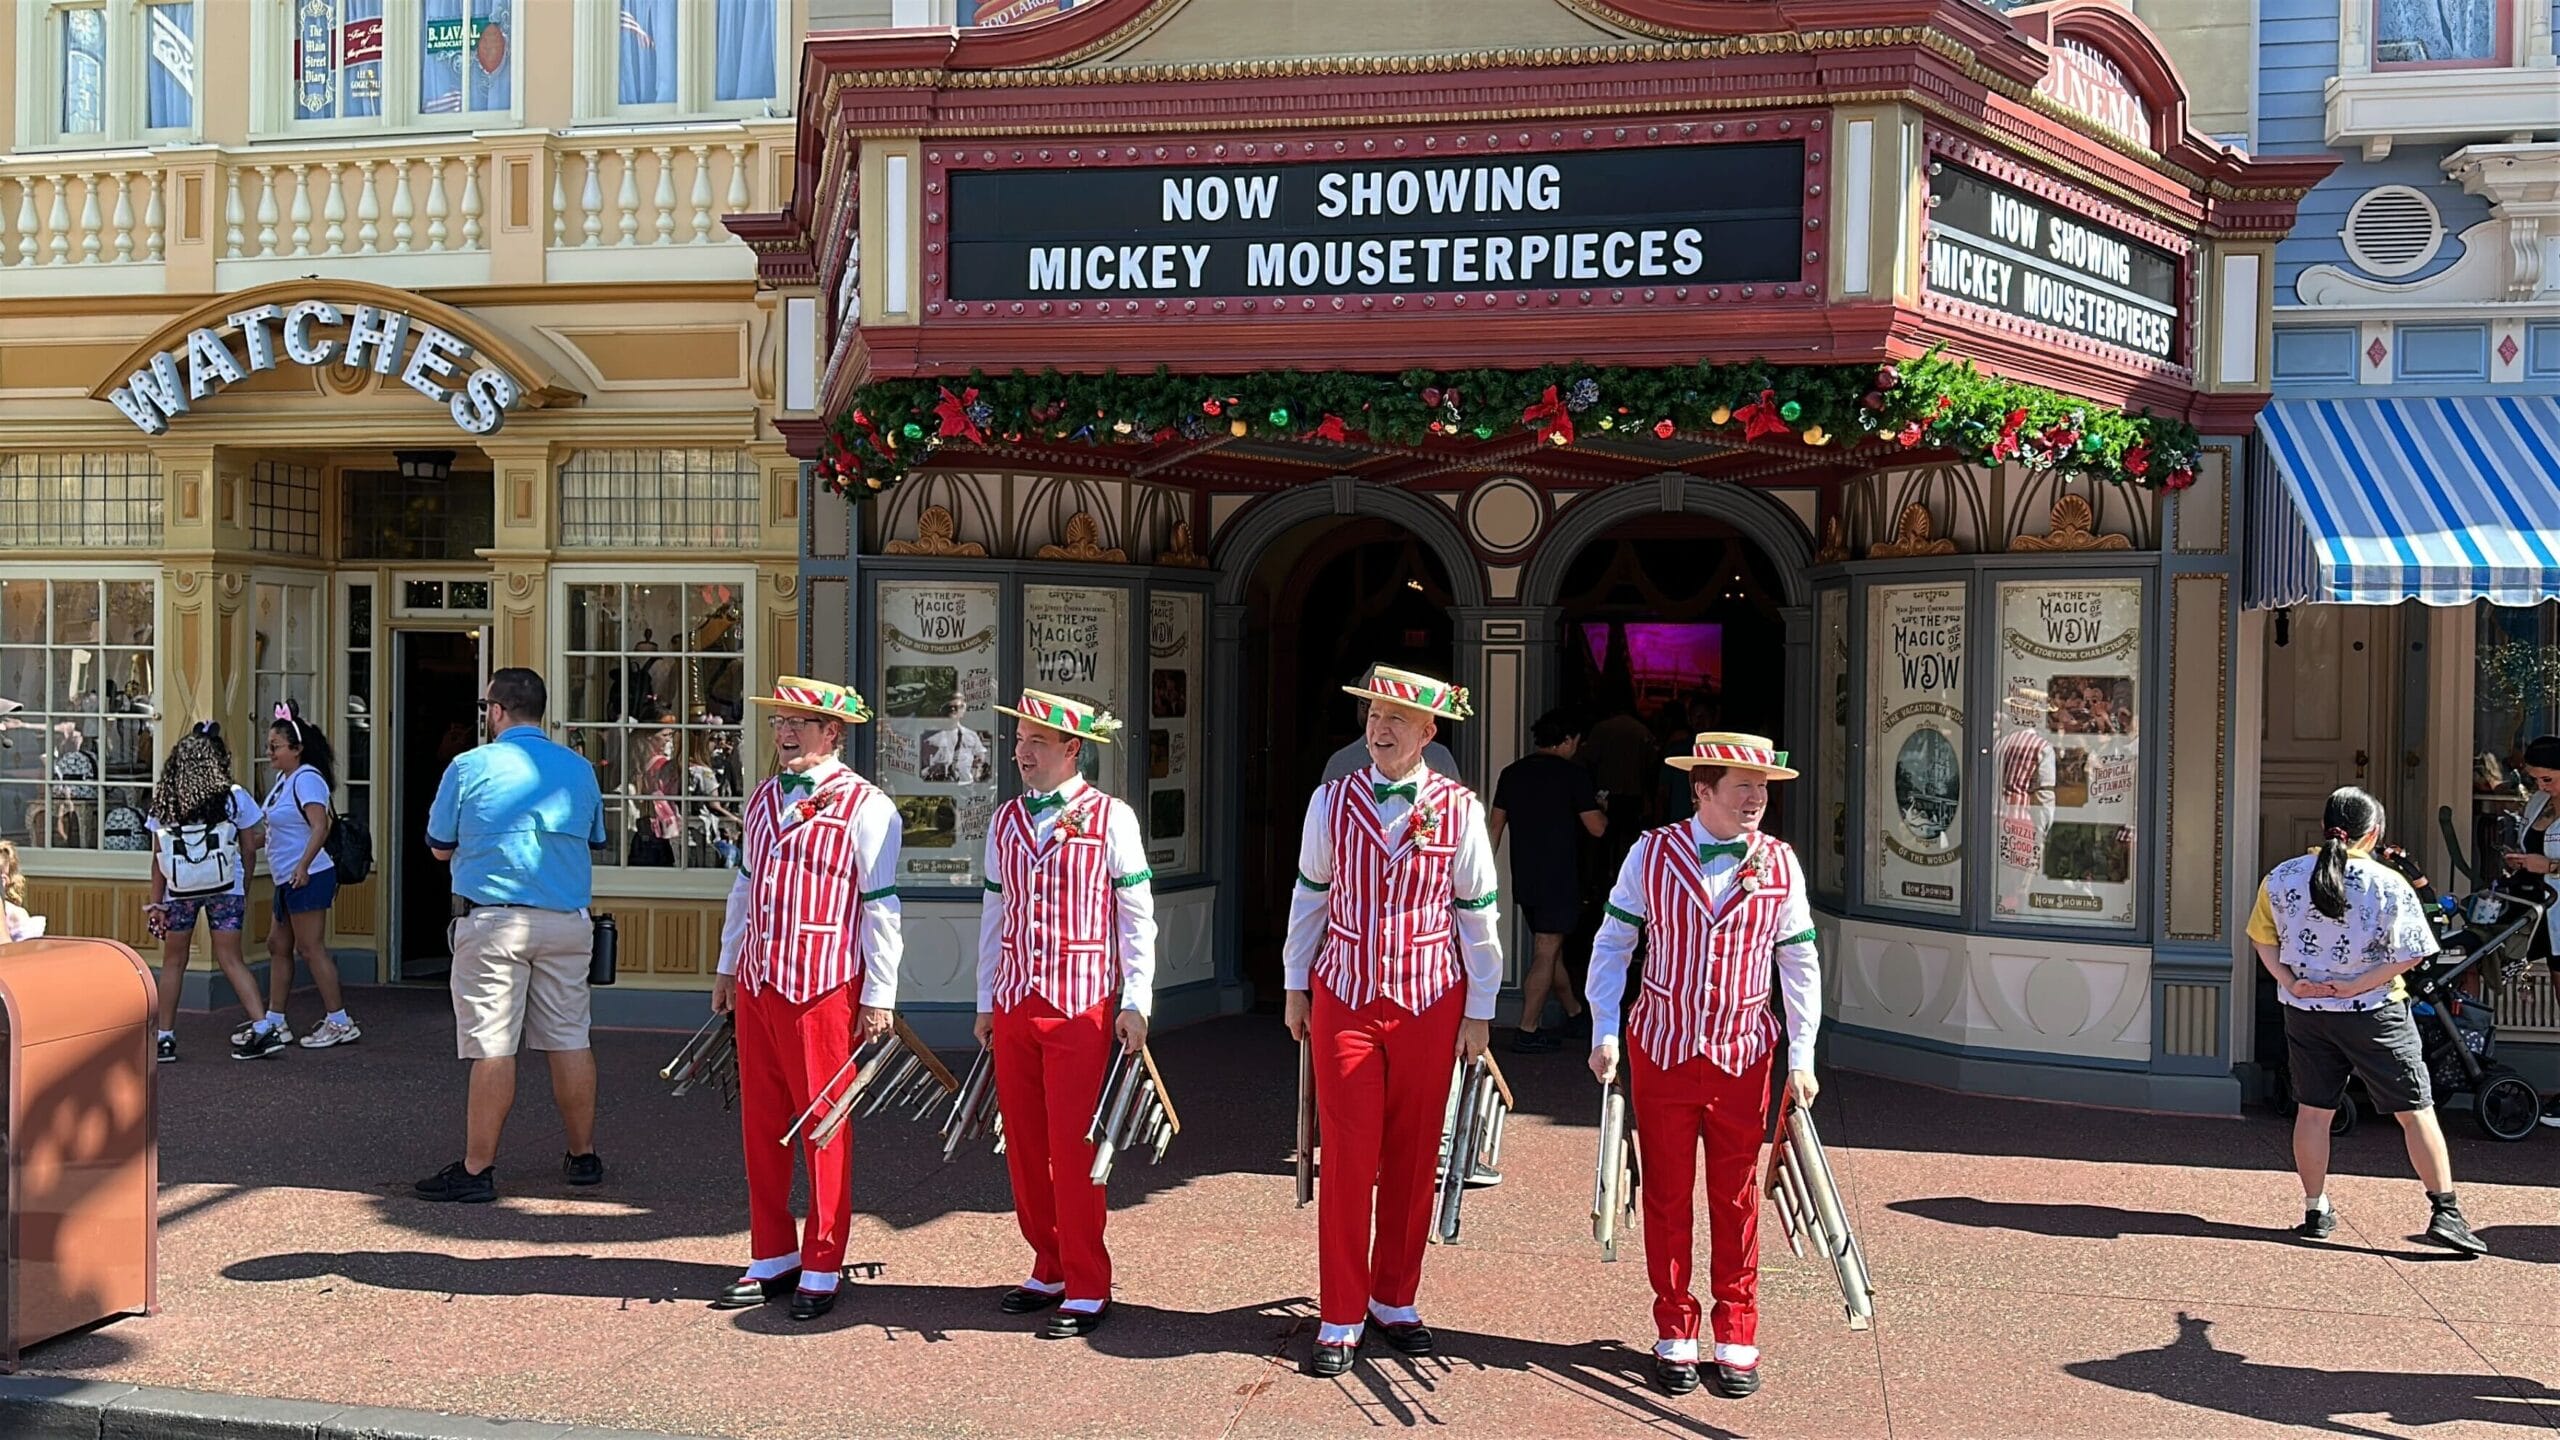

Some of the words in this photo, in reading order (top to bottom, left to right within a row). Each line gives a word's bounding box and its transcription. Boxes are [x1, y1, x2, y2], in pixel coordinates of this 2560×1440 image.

[309, 25, 323, 37] The
[305, 40, 326, 52] Main
[305, 57, 326, 68] Street
[2063, 38, 2104, 84] MAIN
[2105, 59, 2122, 89] ST
[305, 71, 326, 84] Diary
[1162, 175, 1279, 222] NOW
[1317, 164, 1561, 218] SHOWING
[1990, 191, 2039, 250] NOW
[2049, 216, 2131, 286] SHOWING
[1028, 244, 1211, 291] MICKEY
[1247, 228, 1703, 287] MOUSETERPIECES
[1931, 241, 2012, 306] MICKEY
[2023, 271, 2170, 356] MOUSETERPIECES
[107, 300, 519, 435] WATCHES
[934, 592, 950, 600] THE
[2064, 591, 2083, 600] THE
[912, 595, 954, 617] MAGIC
[2037, 596, 2087, 619] MAGIC
[917, 615, 966, 640] WDW
[1056, 614, 1078, 625] THE
[1920, 615, 1941, 626] THE
[1026, 619, 1083, 649] MAGIC
[1085, 631, 1097, 641] OF
[1892, 623, 1945, 655] MAGIC
[1948, 633, 1960, 645] OF
[2043, 617, 2101, 645] WDW
[2033, 646, 2078, 659] STORYBOOK
[1032, 648, 1097, 685] WDW
[1898, 652, 1960, 692] WDW
[1900, 703, 1936, 717] VACATION
[2093, 764, 2131, 783] TROPICAL
[2090, 777, 2132, 796] GETAWAYS
[2003, 819, 2037, 841] GRIZZLY
[2008, 835, 2033, 854] GOOD
[1898, 847, 1908, 857] OF
[1911, 853, 1924, 864] THE
[1927, 851, 1955, 865] WORLD!
[2008, 850, 2031, 868] TIMES
[1905, 882, 1920, 895] NOW
[1920, 883, 1951, 897] SHOWING
[2034, 892, 2056, 908] NOW
[2056, 894, 2099, 909] SHOWING
